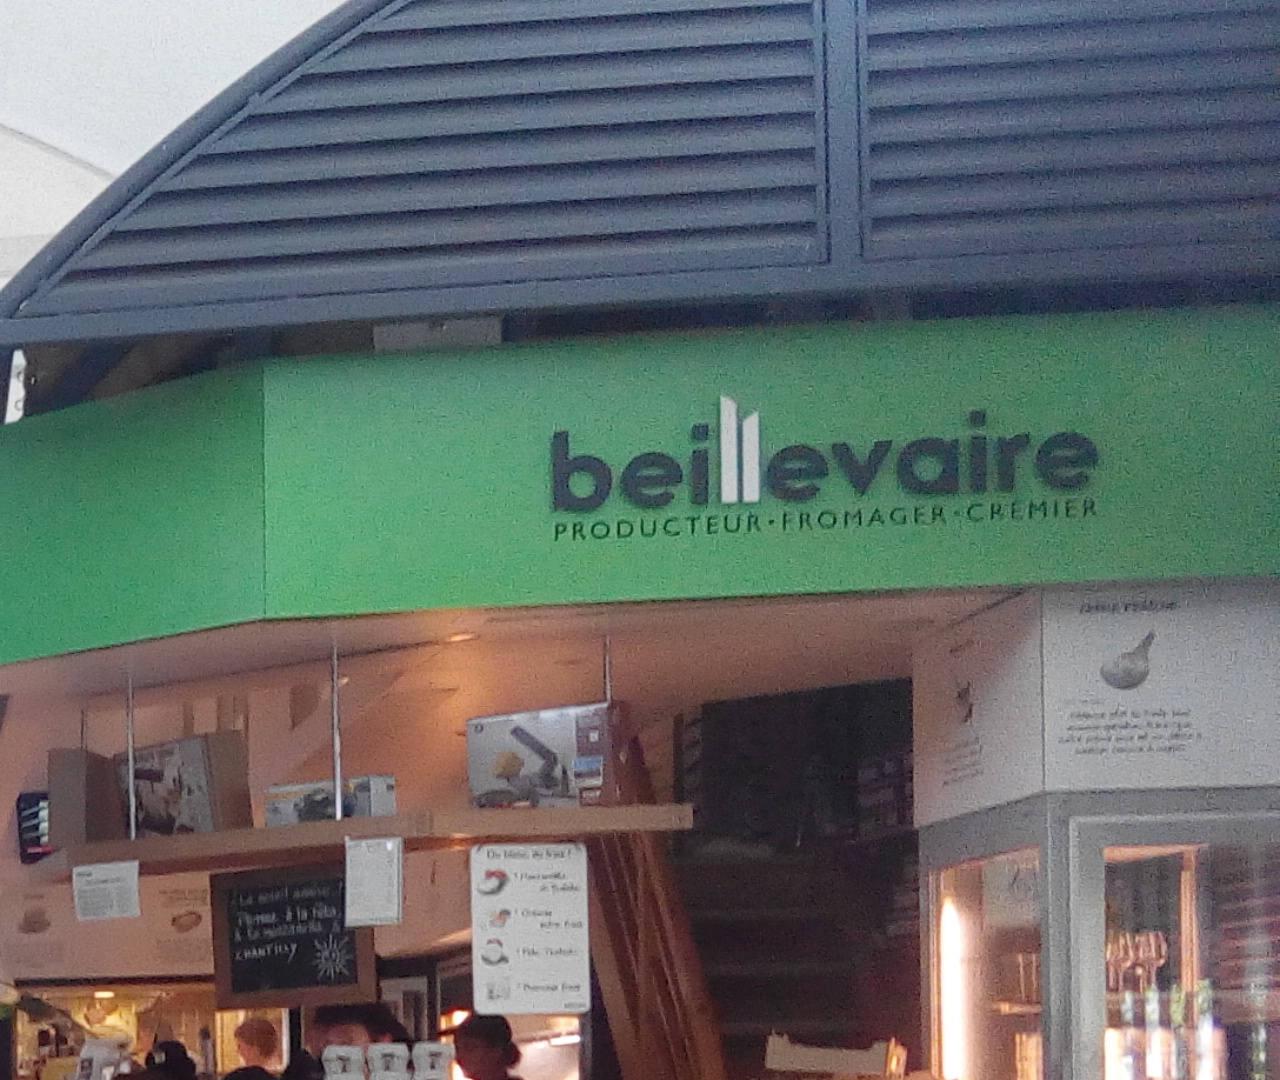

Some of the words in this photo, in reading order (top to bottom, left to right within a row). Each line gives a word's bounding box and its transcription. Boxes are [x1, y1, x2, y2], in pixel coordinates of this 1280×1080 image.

[552, 395, 1099, 513] beillevaire
[553, 512, 761, 541] PRODUCTEUR
[782, 506, 947, 532] FROMAGER
